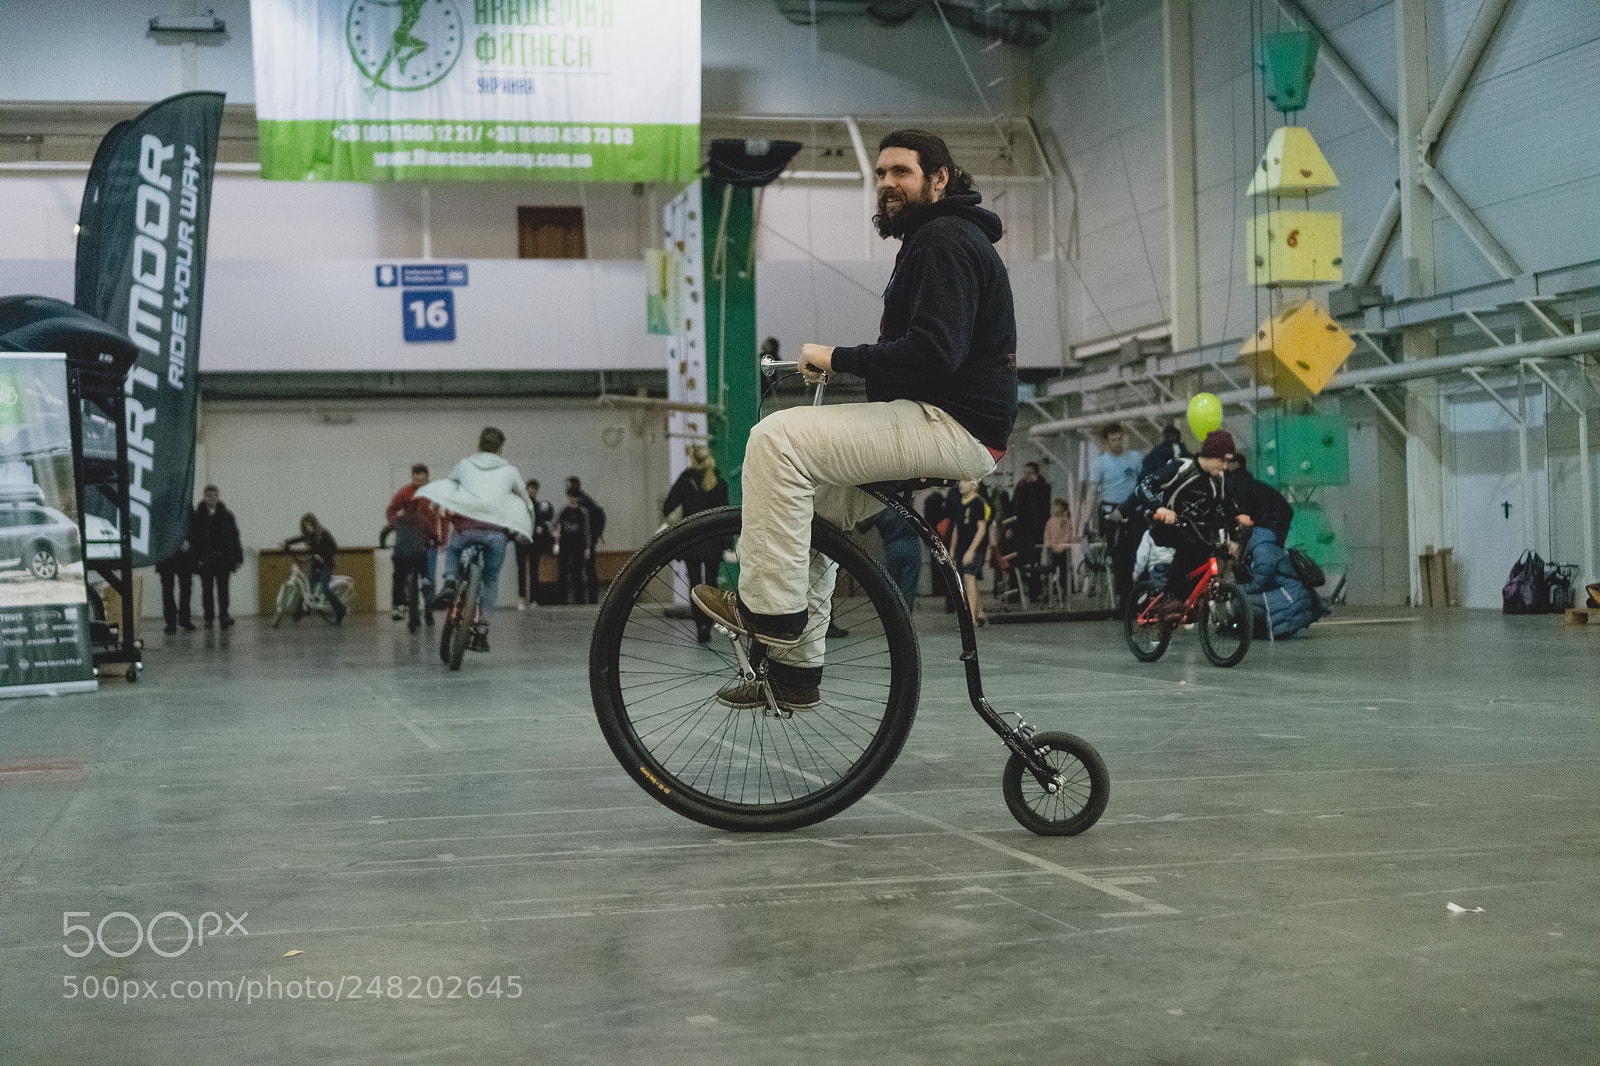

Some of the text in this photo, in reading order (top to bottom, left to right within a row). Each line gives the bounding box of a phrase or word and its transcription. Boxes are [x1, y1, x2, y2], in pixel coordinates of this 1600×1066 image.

[475, 31, 592, 67] ФИТНЕСА
[436, 125, 454, 142] 12
[455, 125, 473, 142] 21
[167, 144, 201, 390] RIDE YOUR WAY
[409, 299, 450, 329] 16
